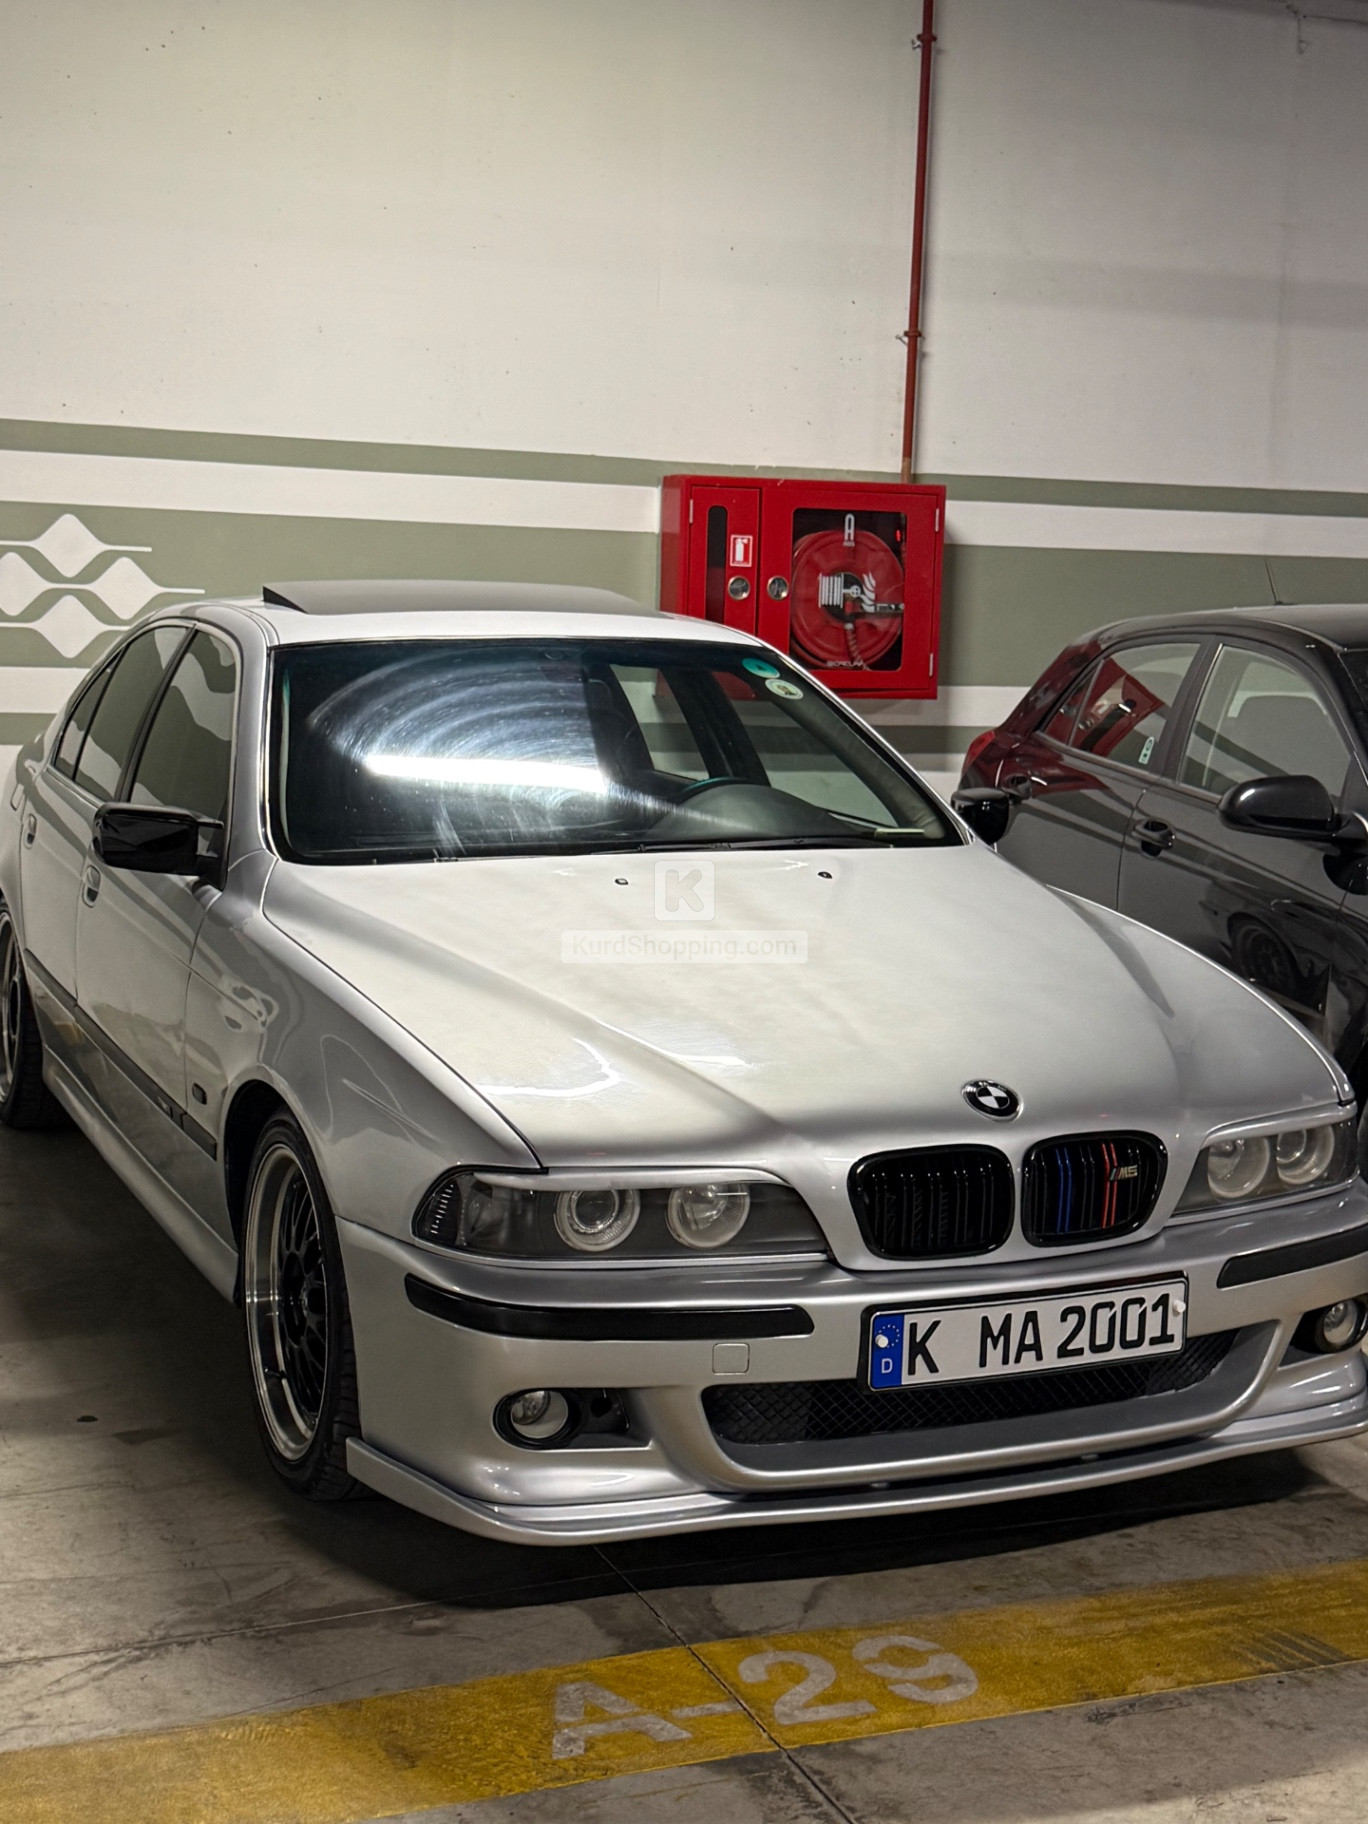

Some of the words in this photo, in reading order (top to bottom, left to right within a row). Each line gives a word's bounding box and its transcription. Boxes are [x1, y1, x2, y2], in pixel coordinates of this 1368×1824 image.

[907, 1320, 942, 1376] K
[979, 1310, 1044, 1369] MA
[1056, 1293, 1175, 1360] 2001
[880, 1358, 894, 1375] D
